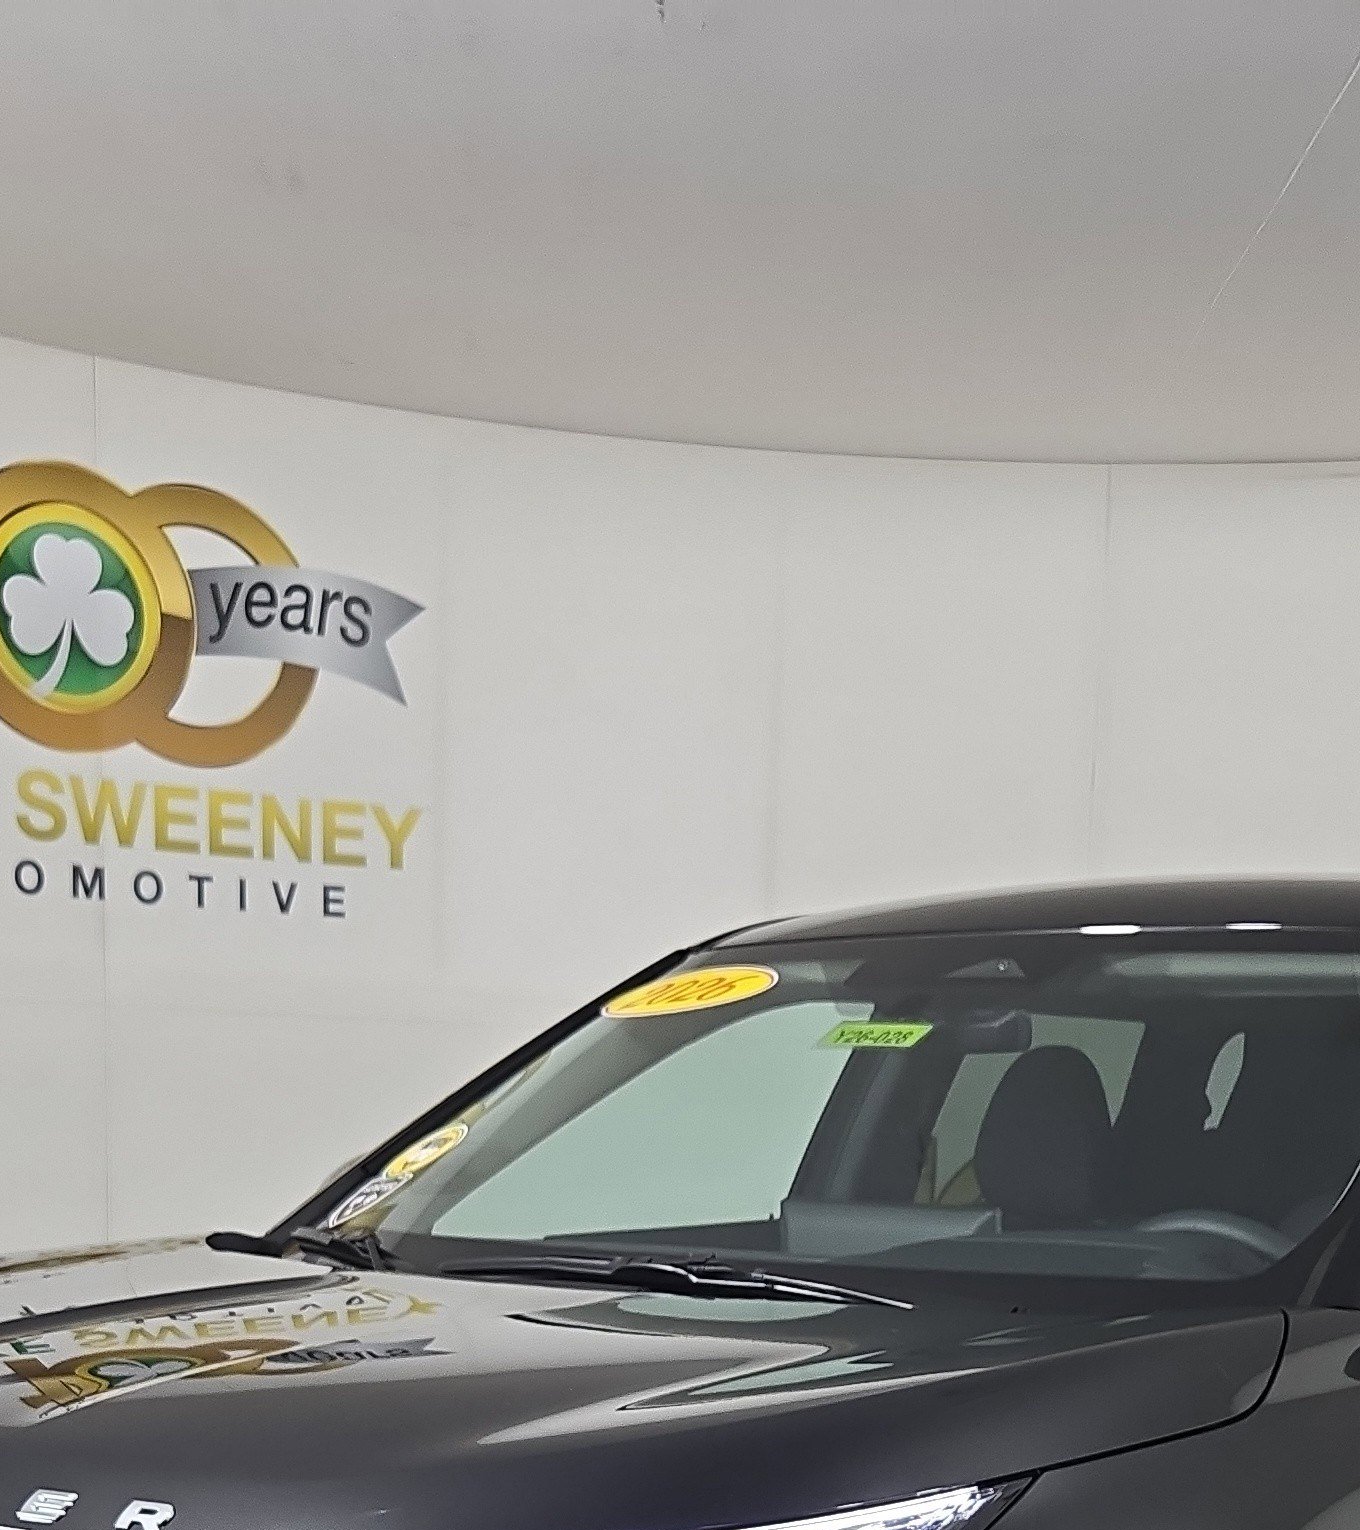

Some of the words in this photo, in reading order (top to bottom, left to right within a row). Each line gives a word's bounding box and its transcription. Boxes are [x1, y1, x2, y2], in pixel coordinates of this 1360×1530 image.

[207, 577, 373, 646] years
[16, 769, 423, 869] SWEENEY
[618, 974, 760, 1010] 2026
